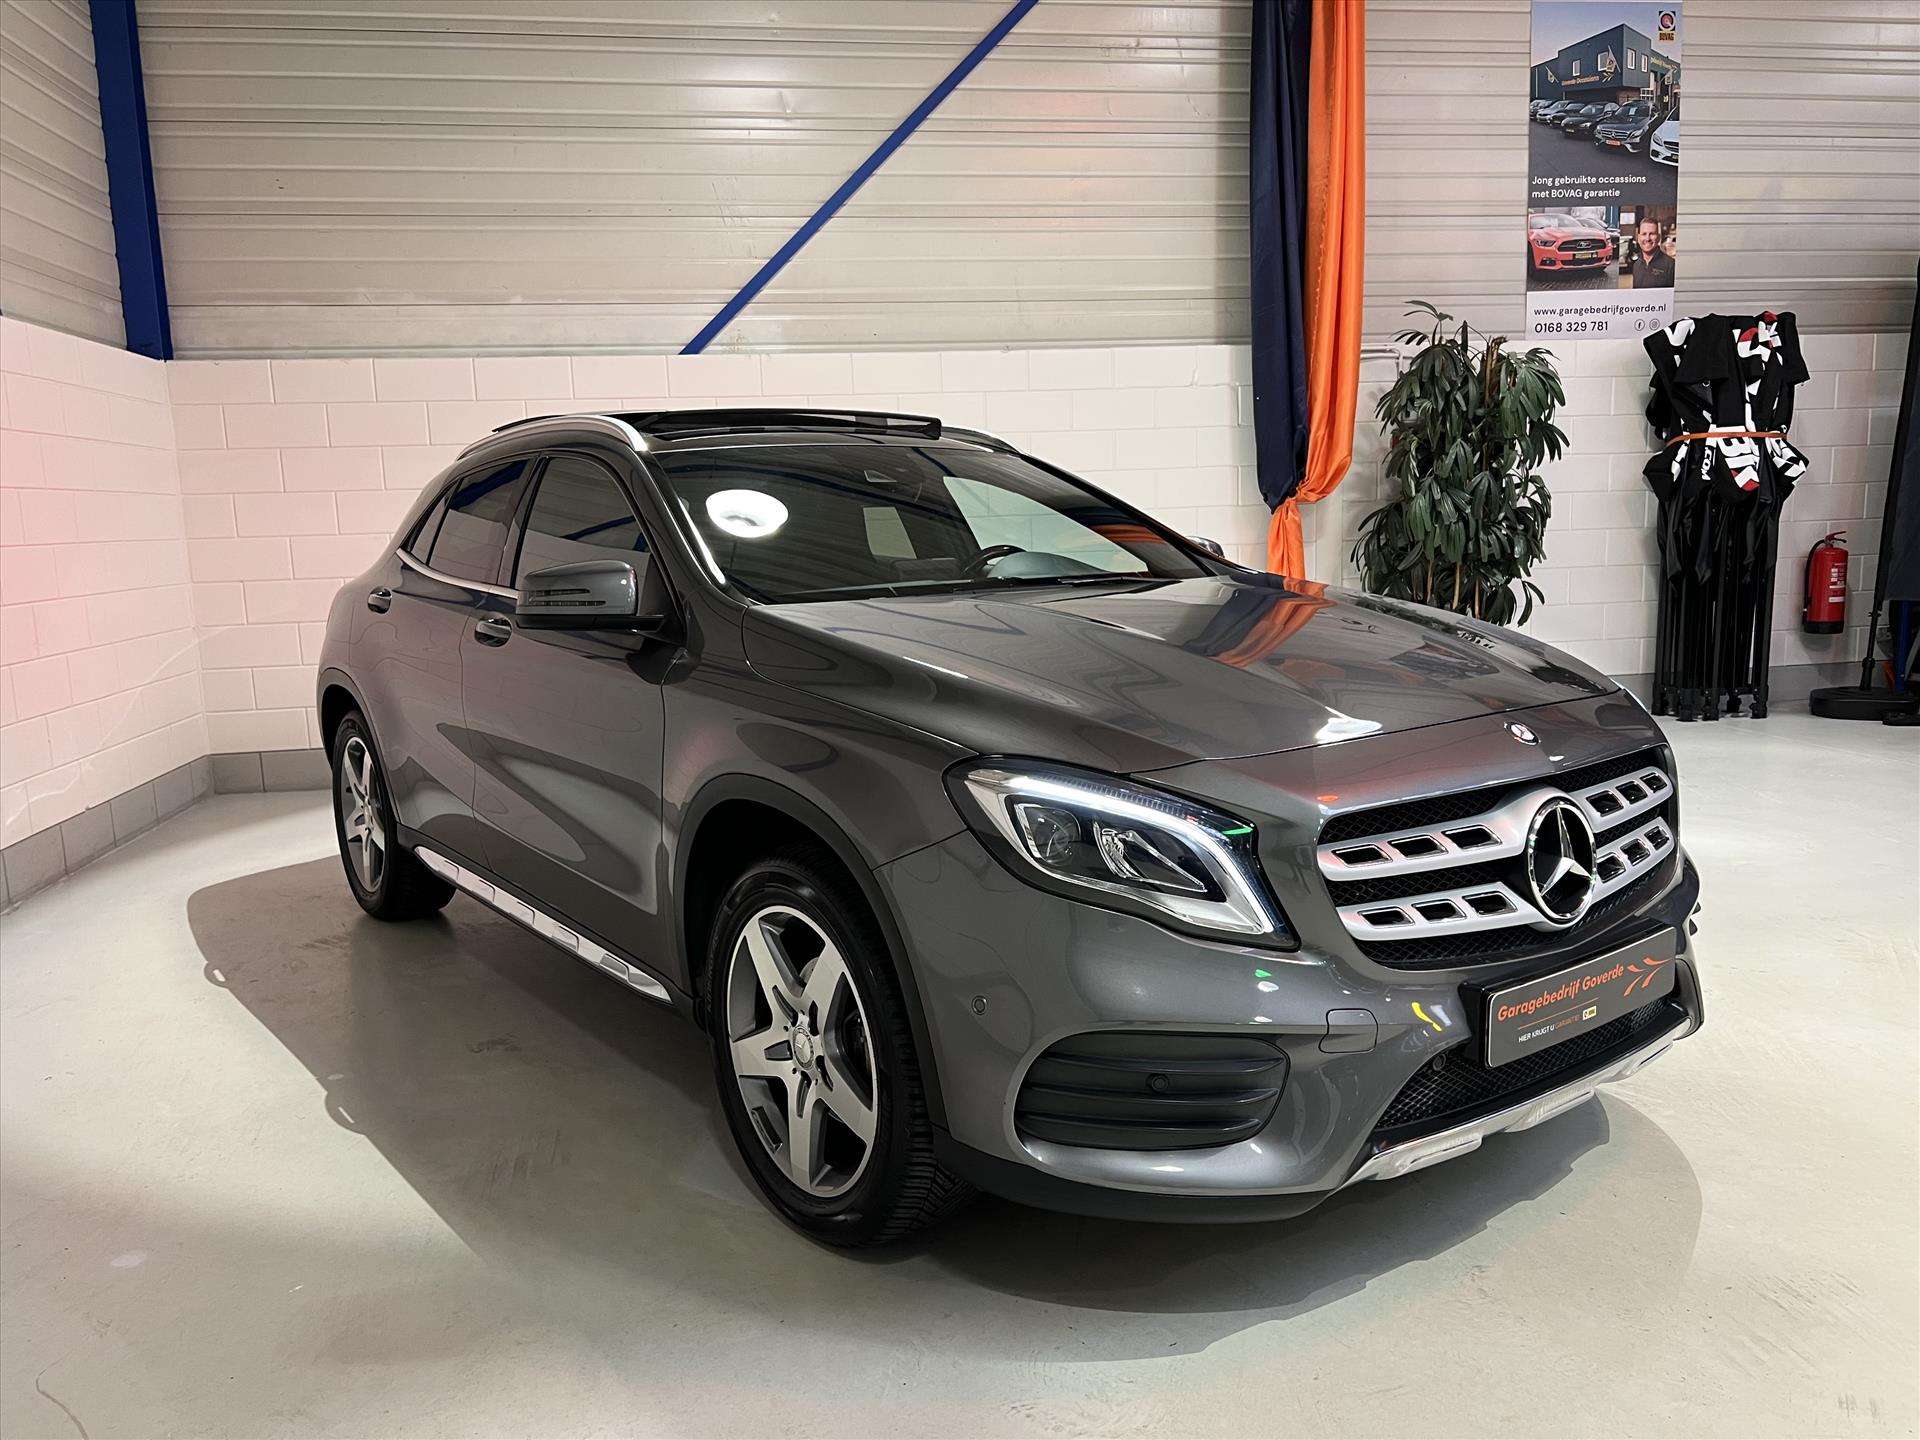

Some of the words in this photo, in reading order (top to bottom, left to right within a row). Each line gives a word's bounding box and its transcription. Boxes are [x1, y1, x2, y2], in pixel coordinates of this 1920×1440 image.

[1532, 176, 1553, 186] Jong
[1555, 175, 1597, 186] gebruikte
[1598, 174, 1647, 184] occassions
[1532, 190, 1549, 198] met
[1551, 189, 1582, 198] BOVAG
[1584, 188, 1620, 199] garantie
[1534, 304, 1666, 316] www.garagebedrijfgoverde.nl
[1535, 322, 1562, 333] 0168
[1566, 321, 1587, 332] 329
[1591, 321, 1608, 331] 781
[1498, 981, 1580, 1022] Garagebedrijf
[1583, 964, 1625, 991] Goverde
[1519, 1033, 1532, 1043] HIER
